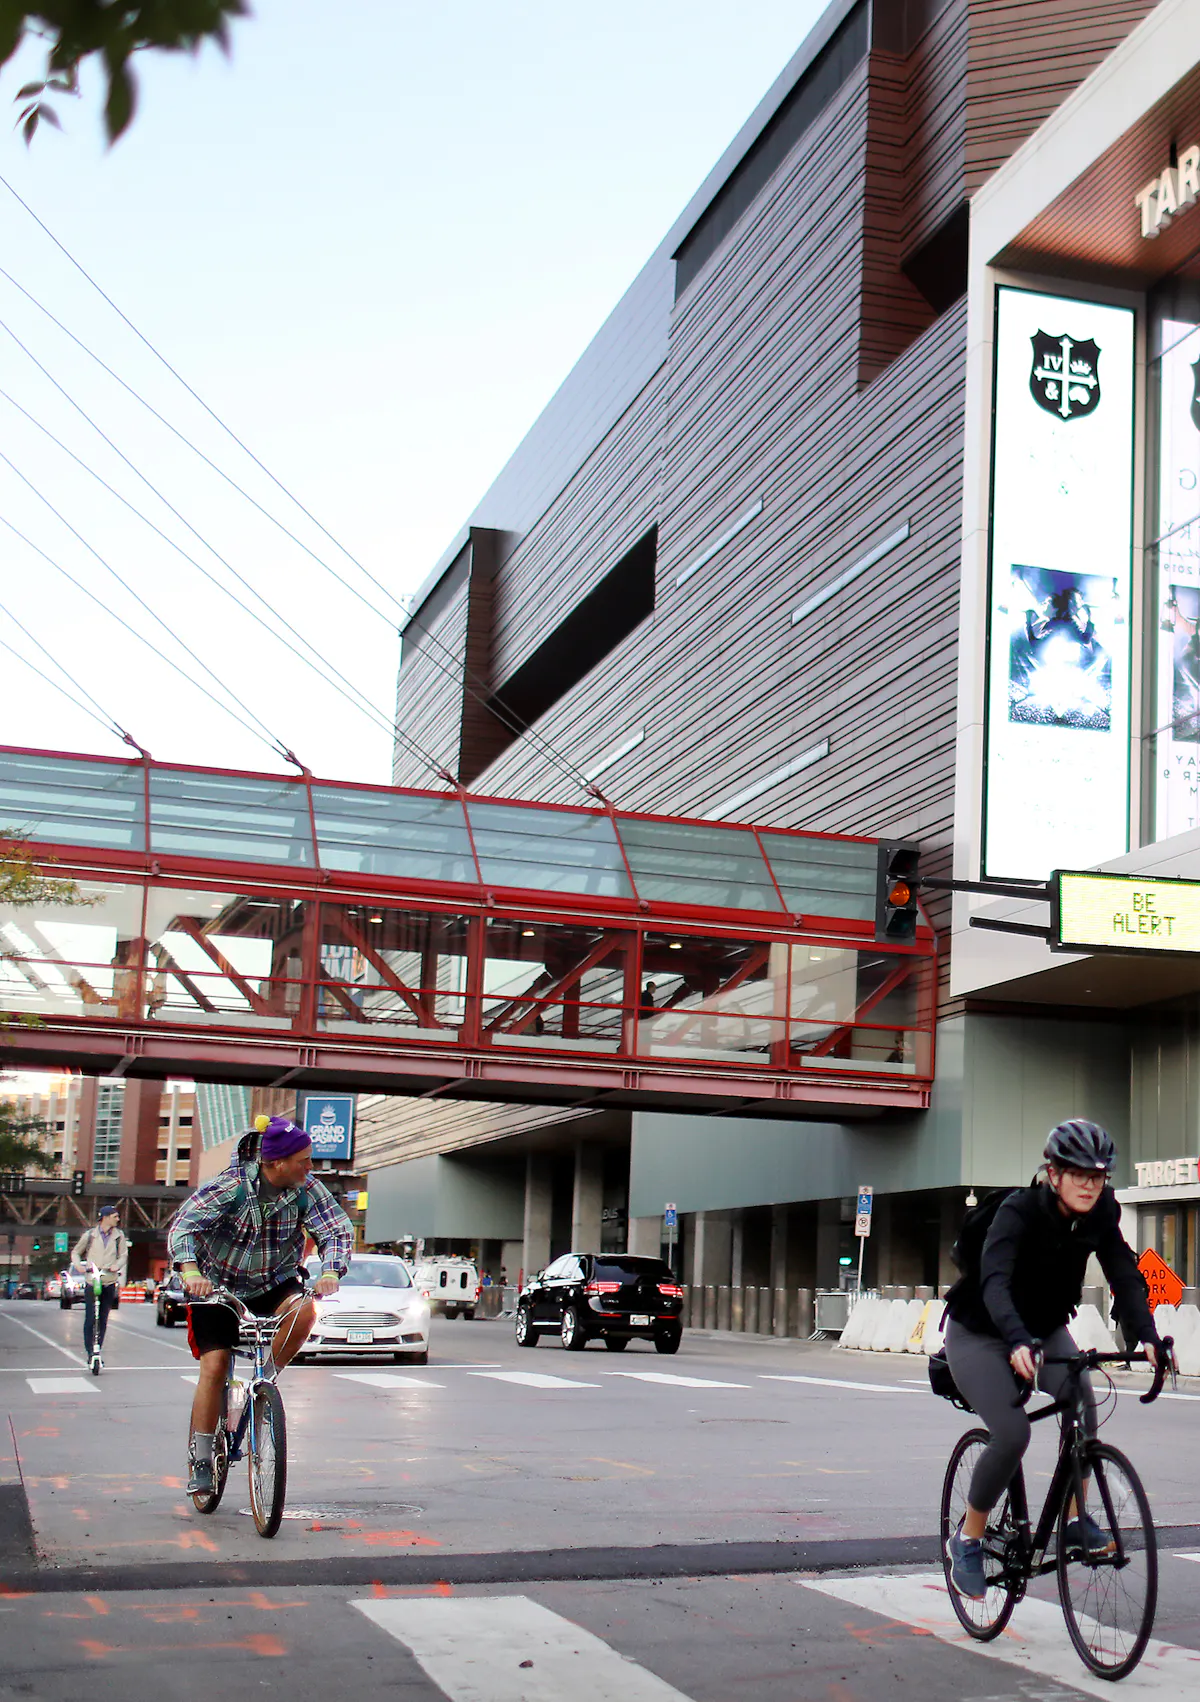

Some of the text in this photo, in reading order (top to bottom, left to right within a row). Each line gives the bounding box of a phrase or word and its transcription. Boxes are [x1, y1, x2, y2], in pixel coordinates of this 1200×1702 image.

[1133, 892, 1157, 913] BE
[1113, 913, 1176, 936] ALERT
[310, 1125, 345, 1135] GRAND
[310, 1134, 345, 1144] CASINO
[1135, 1157, 1199, 1188] TARGET
[1142, 1269, 1166, 1280] OAD
